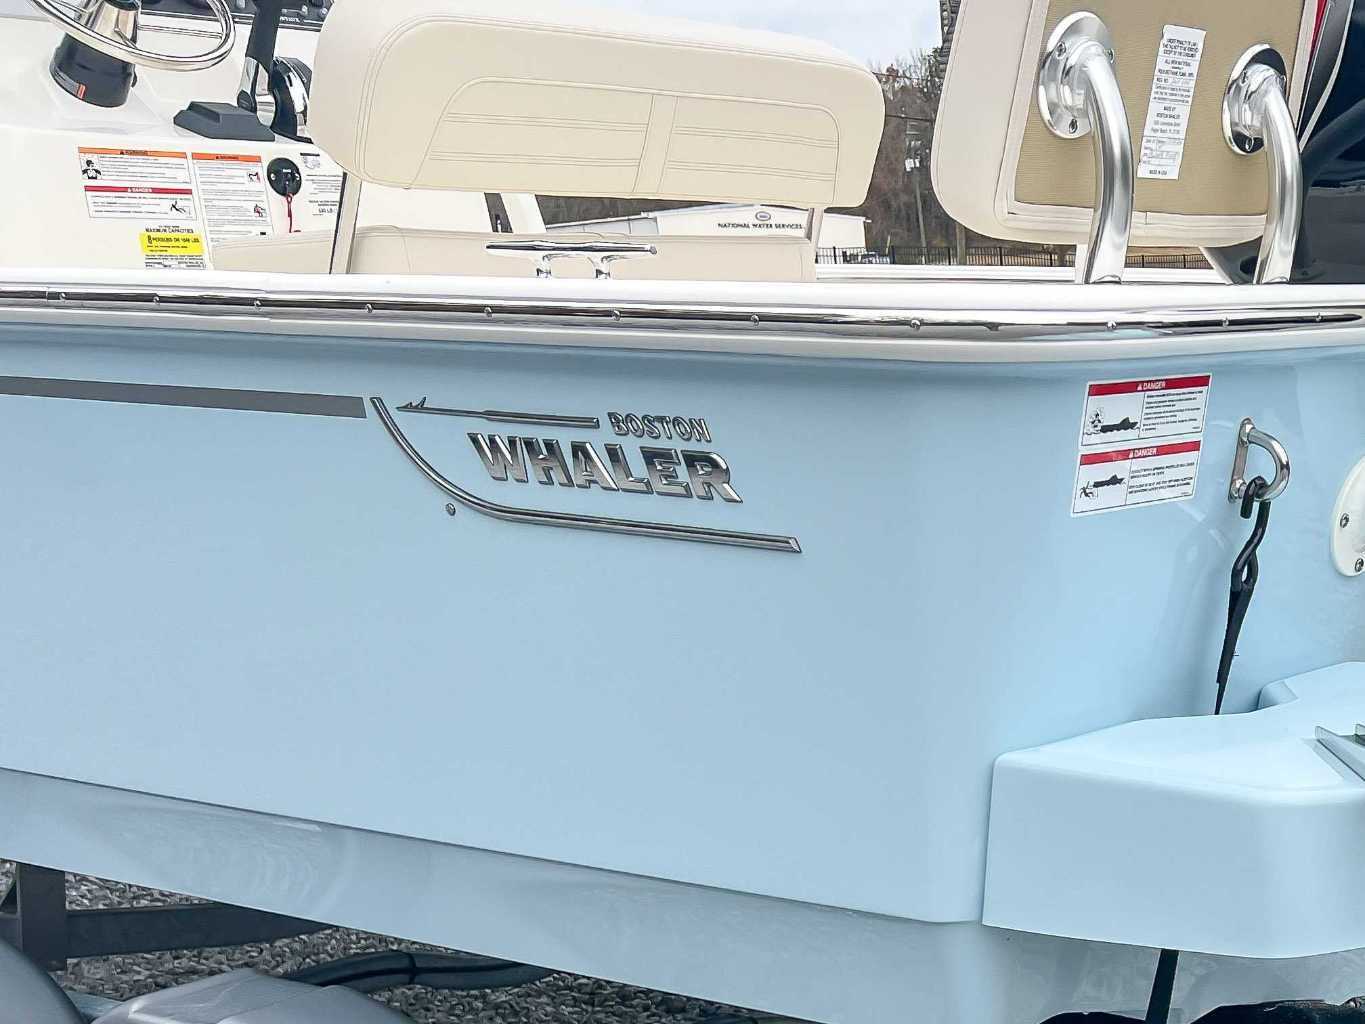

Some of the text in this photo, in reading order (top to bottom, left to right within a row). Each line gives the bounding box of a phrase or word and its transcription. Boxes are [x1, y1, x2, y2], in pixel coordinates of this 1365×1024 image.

[1142, 381, 1166, 391] DANGER
[607, 411, 712, 443] BOSTON
[1134, 447, 1157, 458] DANGER
[467, 432, 743, 504] WHALER
